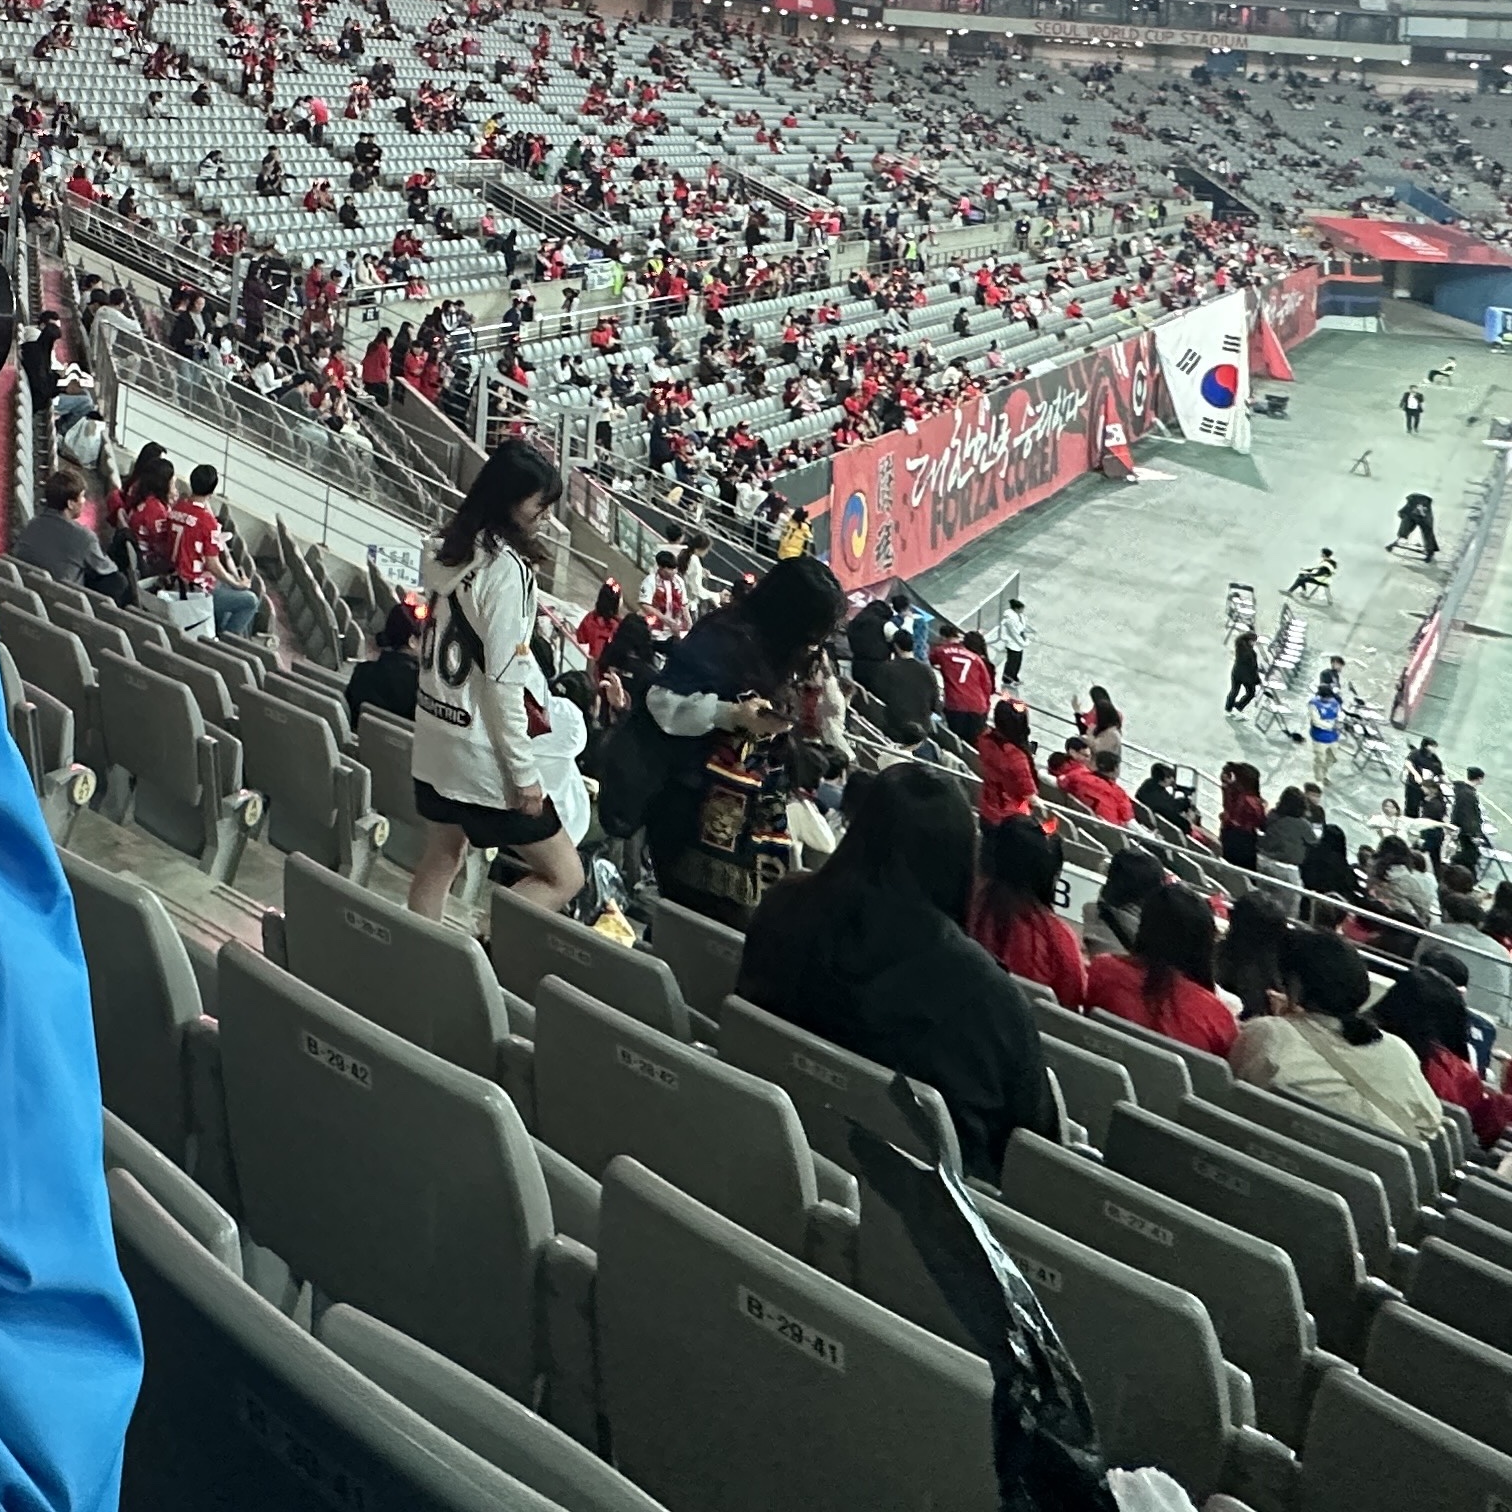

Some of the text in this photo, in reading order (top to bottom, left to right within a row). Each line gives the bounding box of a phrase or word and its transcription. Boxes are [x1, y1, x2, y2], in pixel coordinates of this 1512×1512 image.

[1034, 22, 1249, 49] SEOUL WORLD CUP STADIUM
[952, 656, 972, 683] 7
[1051, 878, 1071, 909] B
[306, 1035, 369, 1085] B-29-42
